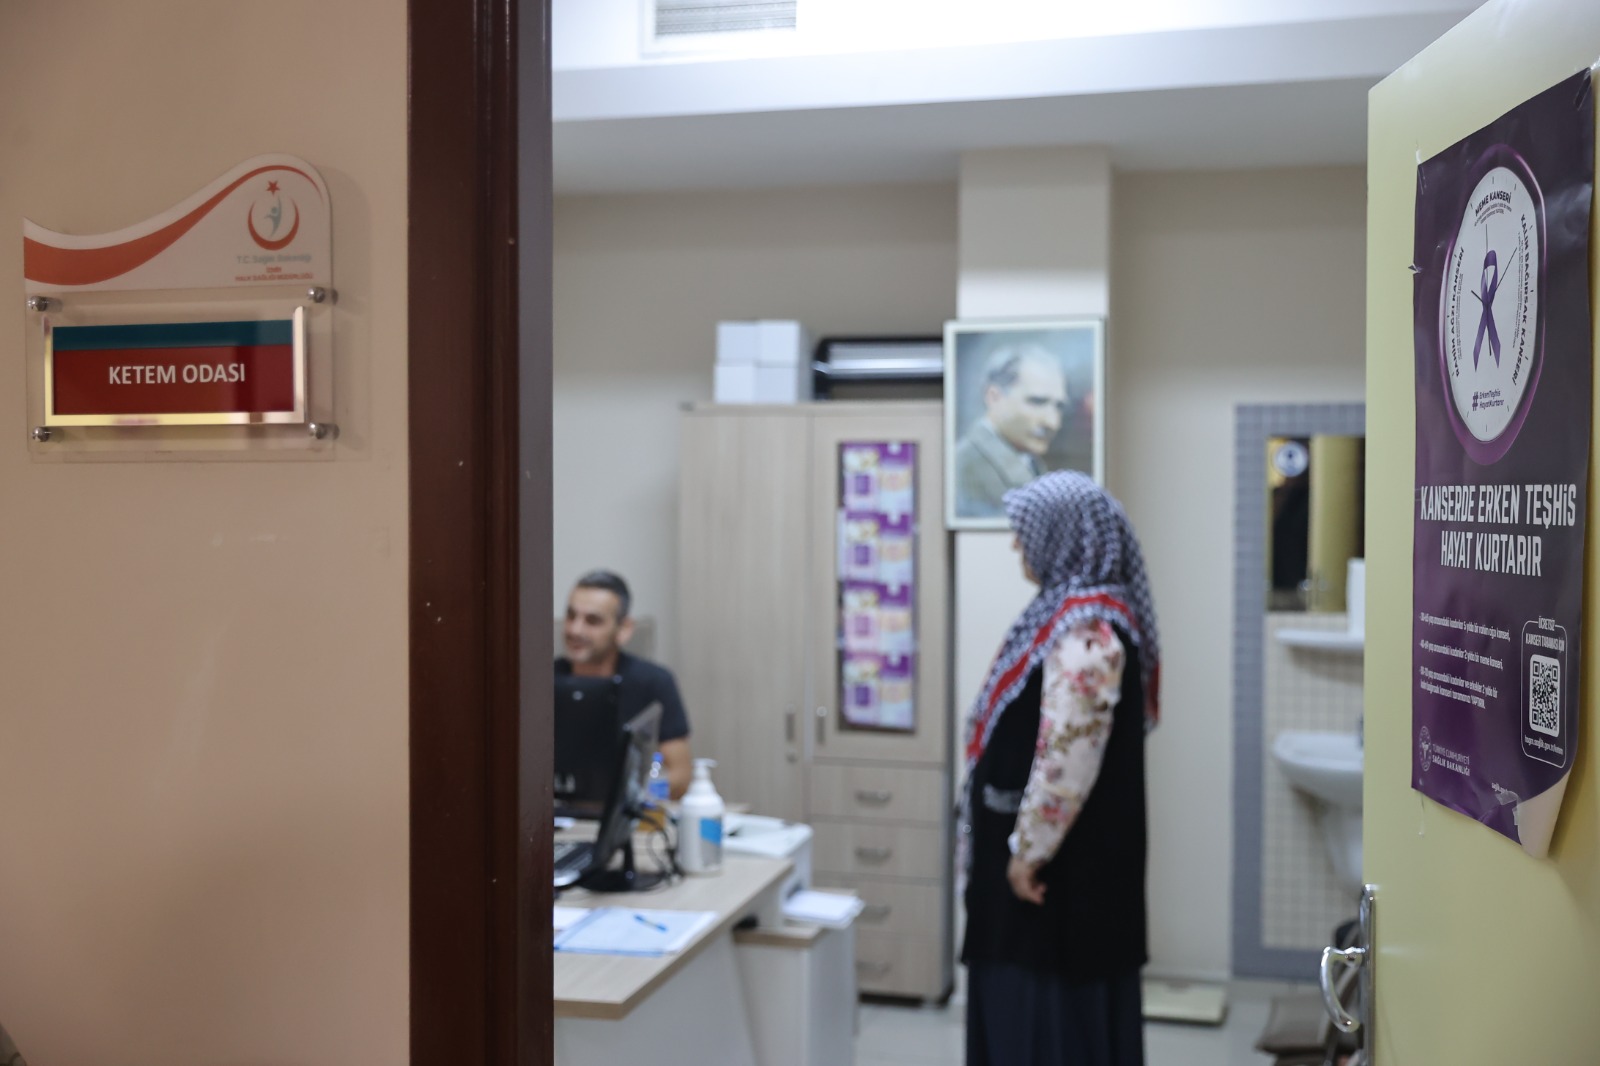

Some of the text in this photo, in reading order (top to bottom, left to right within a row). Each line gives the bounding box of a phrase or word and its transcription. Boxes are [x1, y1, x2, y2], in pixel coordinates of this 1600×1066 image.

[1475, 195, 1489, 217] MEME
[1489, 190, 1512, 204] KANSERİ
[1521, 213, 1529, 250] KALIN
[1452, 246, 1464, 301] KANSERİ
[1523, 252, 1531, 324] BAĞIRSAK
[109, 363, 246, 385] KETEM ODASI
[1452, 338, 1460, 377] RAHİM
[1512, 327, 1527, 387] KANSERİ
[1420, 483, 1577, 529] KANSERDE ERKEN TEŞHİS
[1440, 530, 1542, 577] HAYAT KURTARIR
[1432, 754, 1471, 777] SAĞLIK BAKANLIĞI
